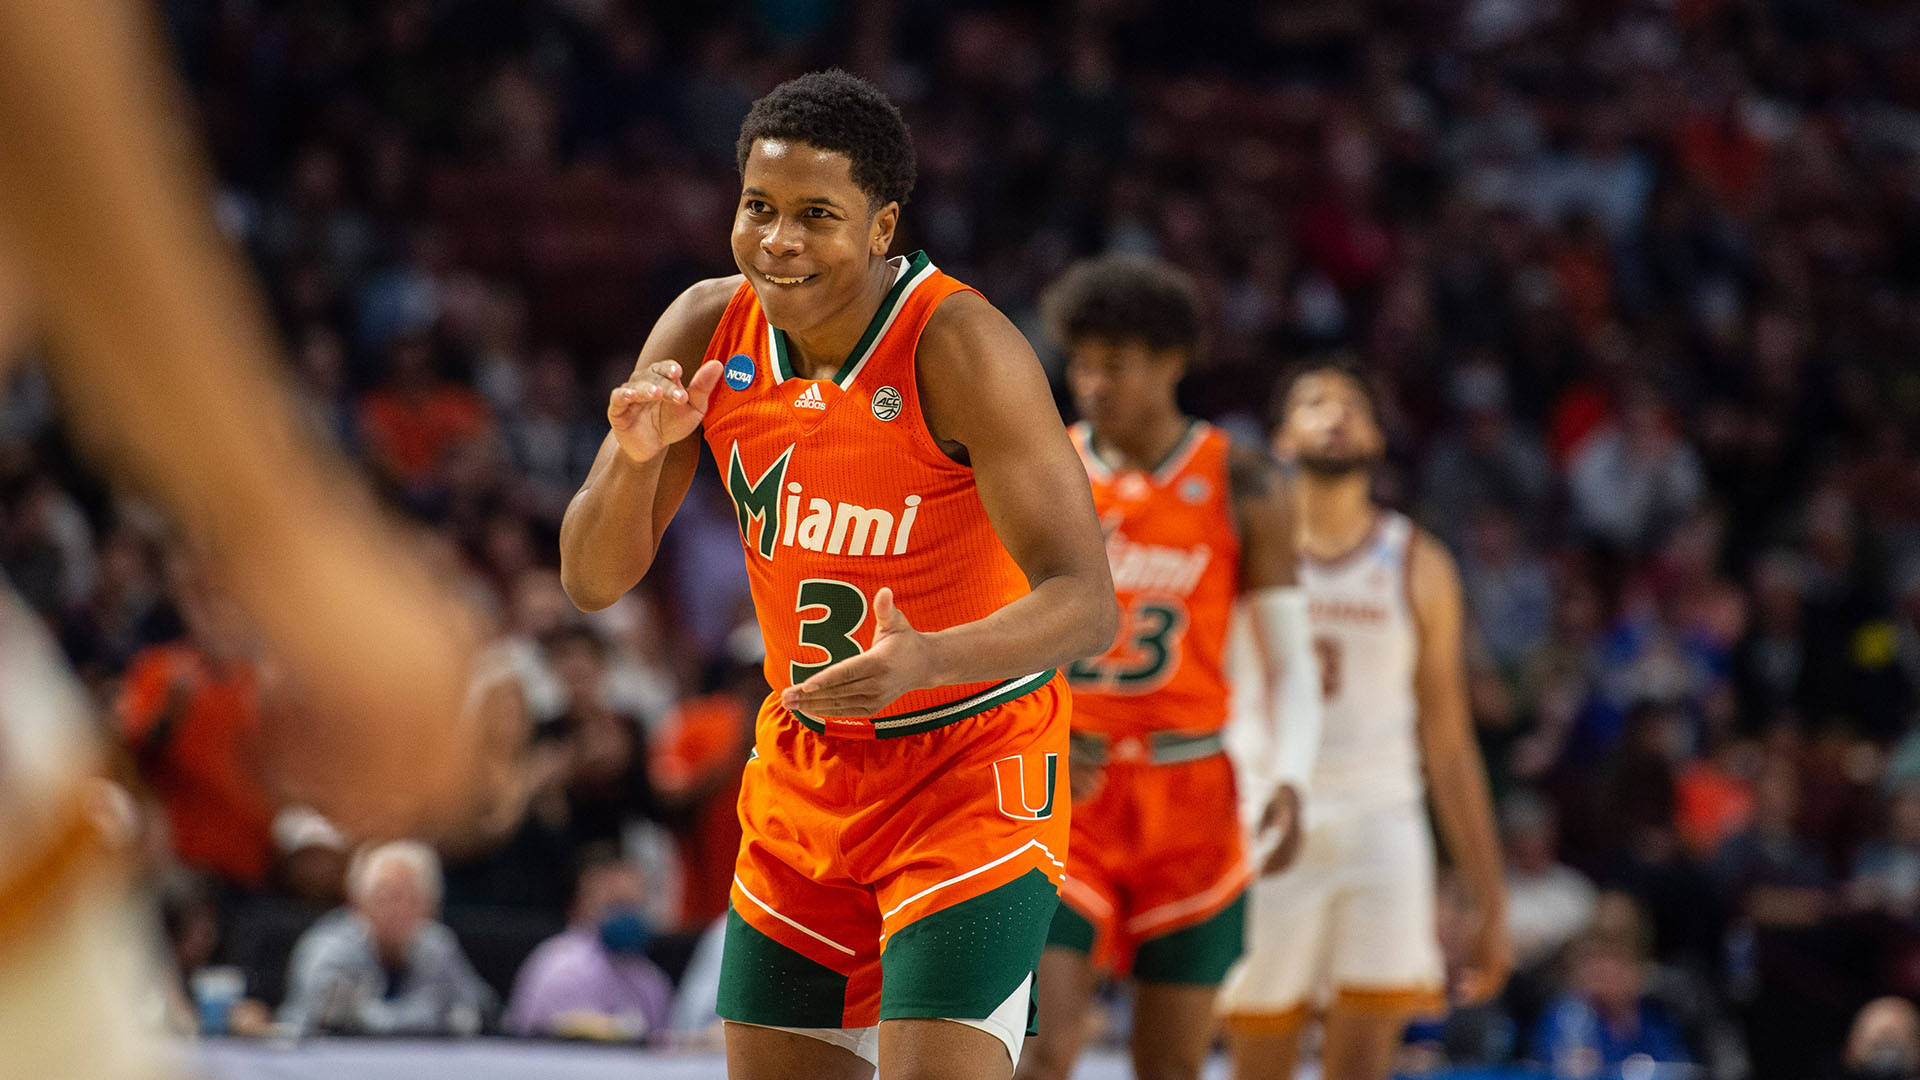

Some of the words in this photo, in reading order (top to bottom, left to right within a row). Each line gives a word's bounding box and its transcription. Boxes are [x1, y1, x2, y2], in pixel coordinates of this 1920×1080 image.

[727, 369, 753, 383] NCAA
[794, 399, 826, 411] adidas
[877, 397, 900, 408] ACC
[727, 438, 922, 561] Miami
[790, 578, 868, 687] 3
